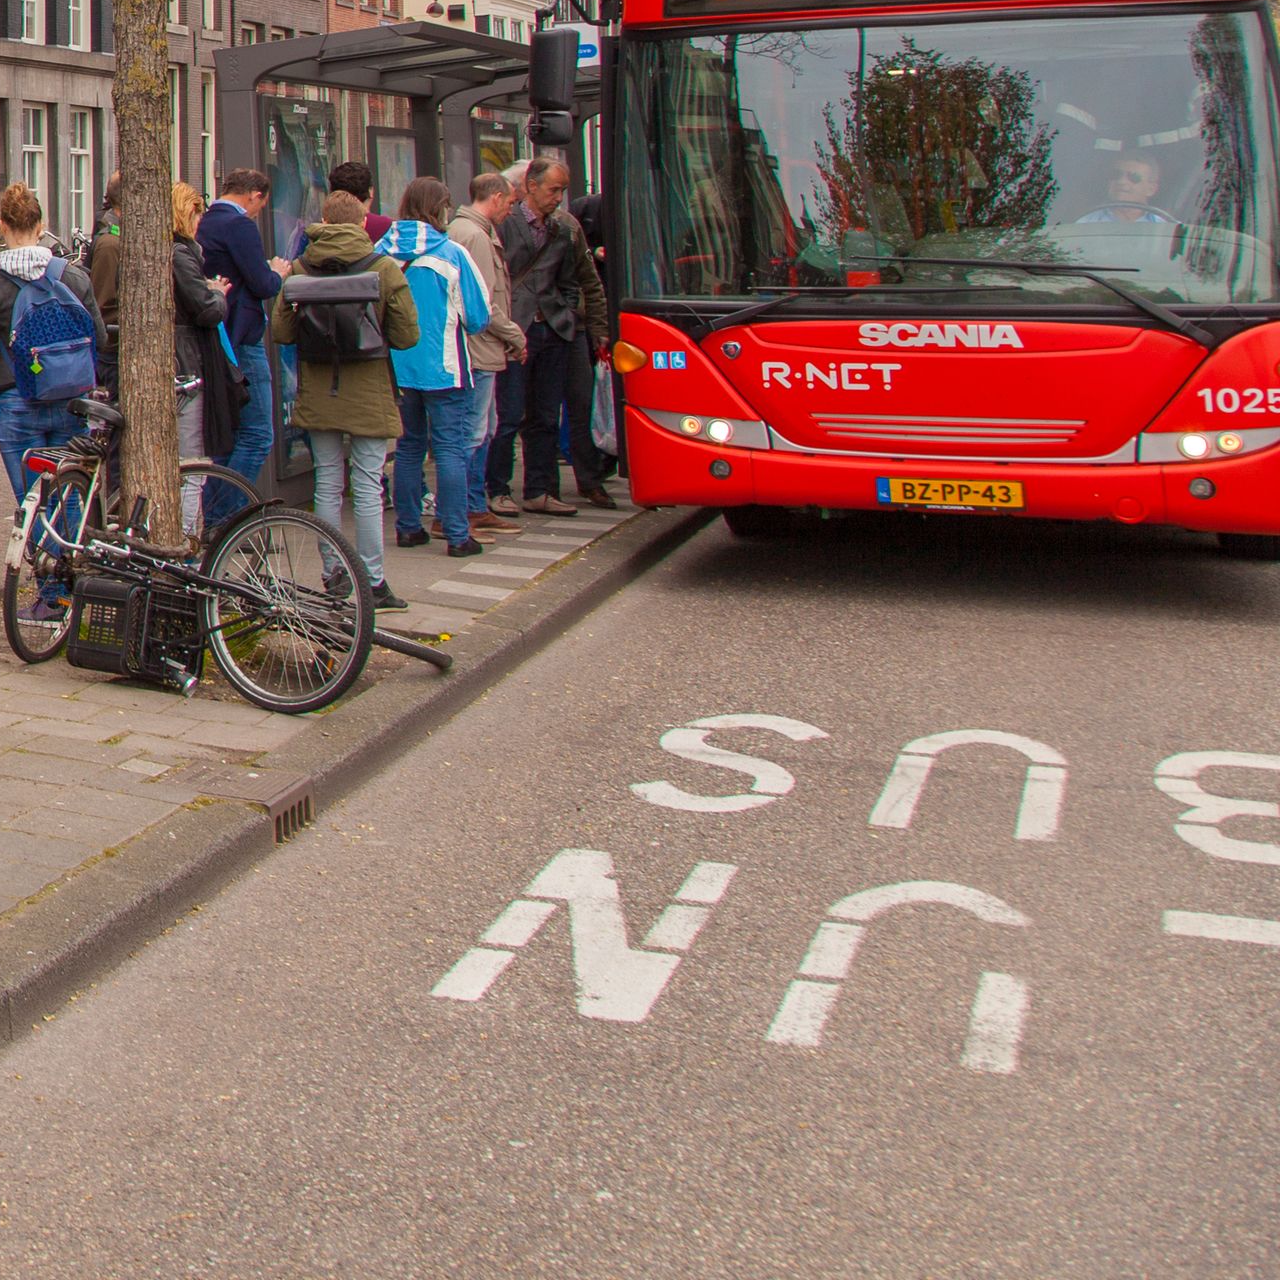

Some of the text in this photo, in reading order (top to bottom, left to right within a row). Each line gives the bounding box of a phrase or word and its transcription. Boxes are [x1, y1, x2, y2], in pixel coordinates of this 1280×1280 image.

[857, 322, 1025, 349] SCANIA
[1196, 387, 1280, 414] 1025
[901, 482, 1012, 504] BZ-PP-43
